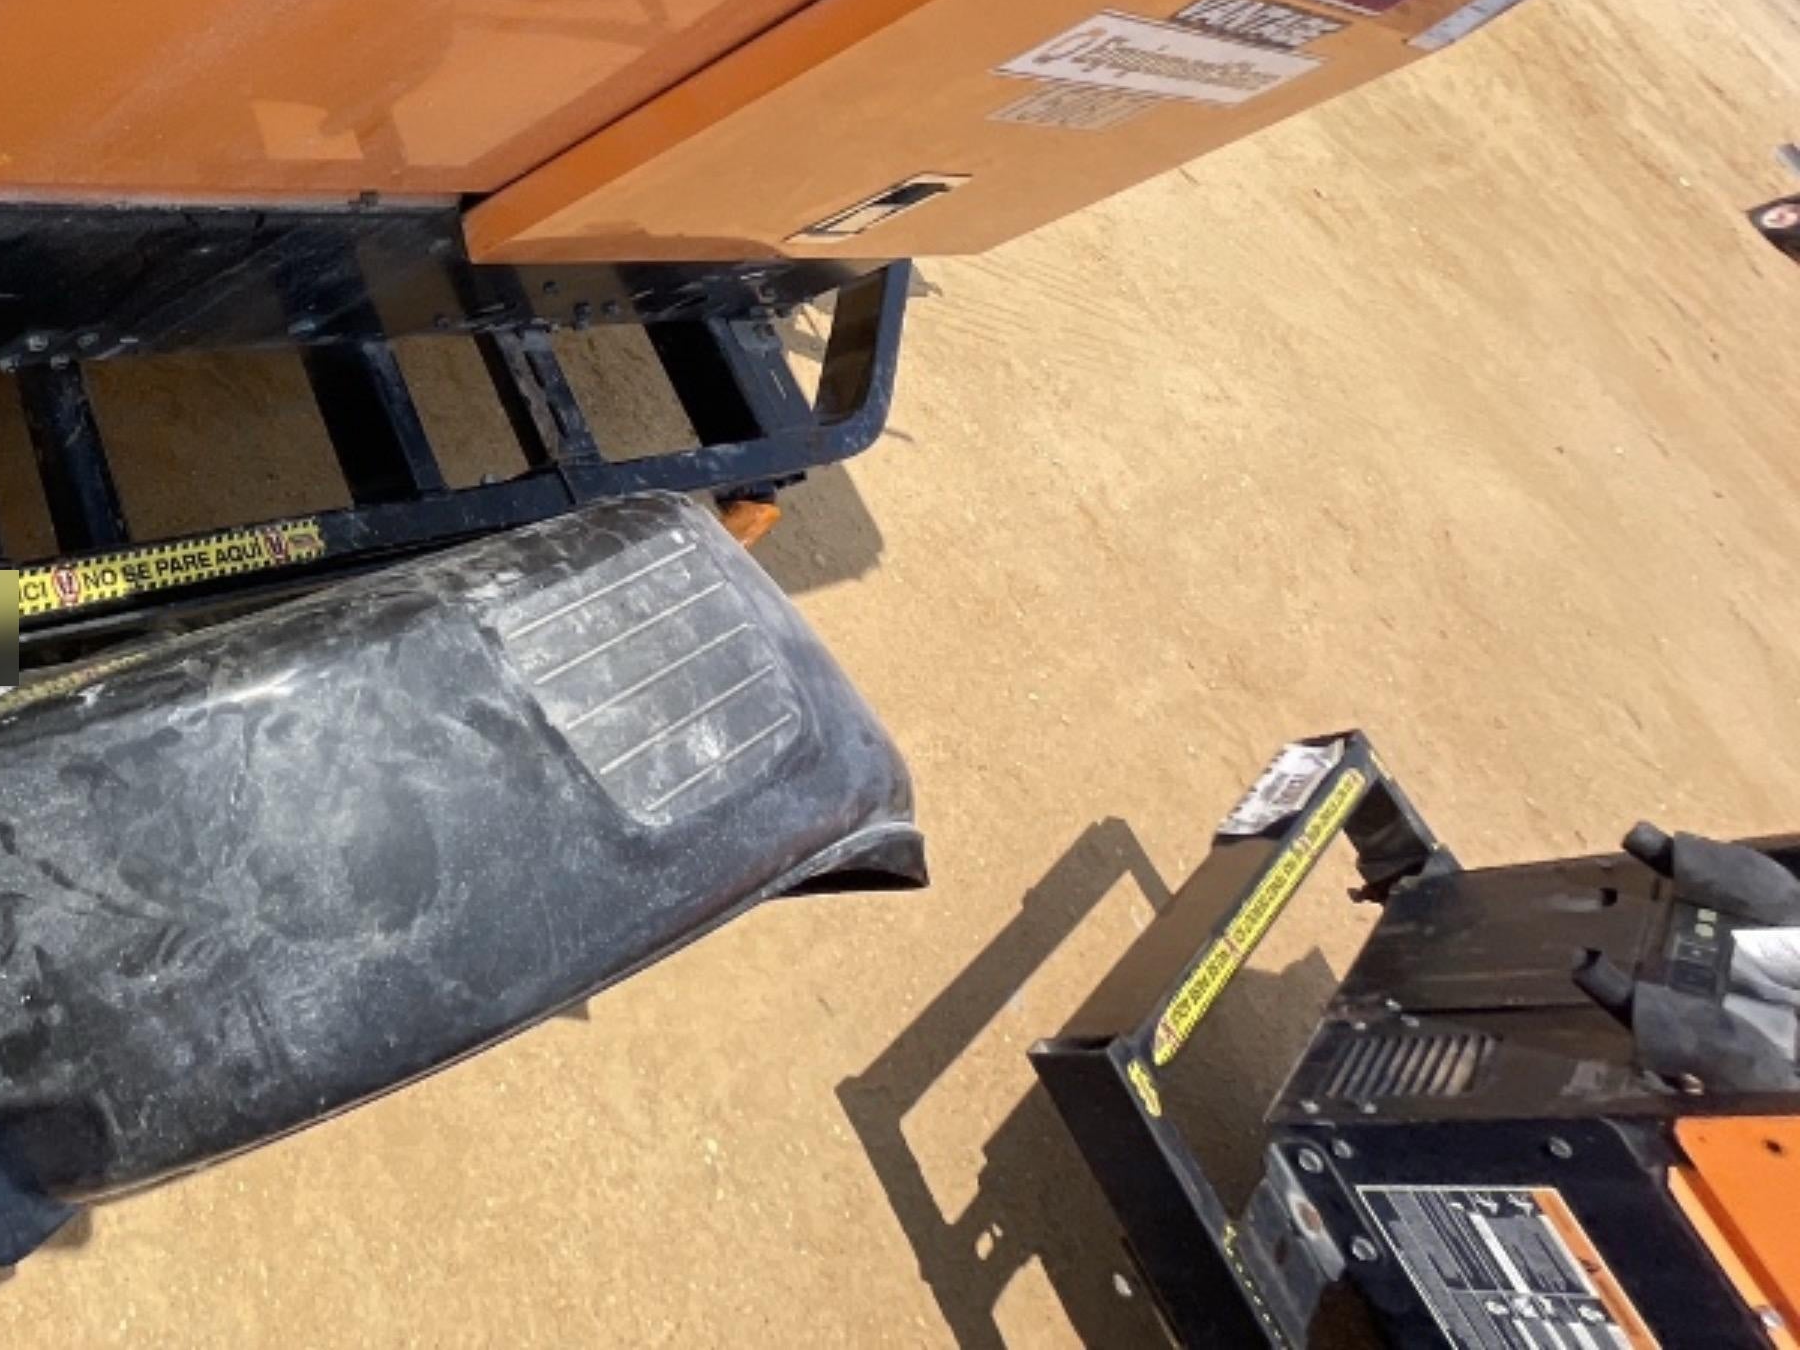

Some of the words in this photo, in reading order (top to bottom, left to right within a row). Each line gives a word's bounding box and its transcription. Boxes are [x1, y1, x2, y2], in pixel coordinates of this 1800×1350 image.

[19, 580, 49, 601] CI
[82, 567, 118, 590] NO
[121, 560, 153, 583] SE
[153, 551, 213, 577] PARE
